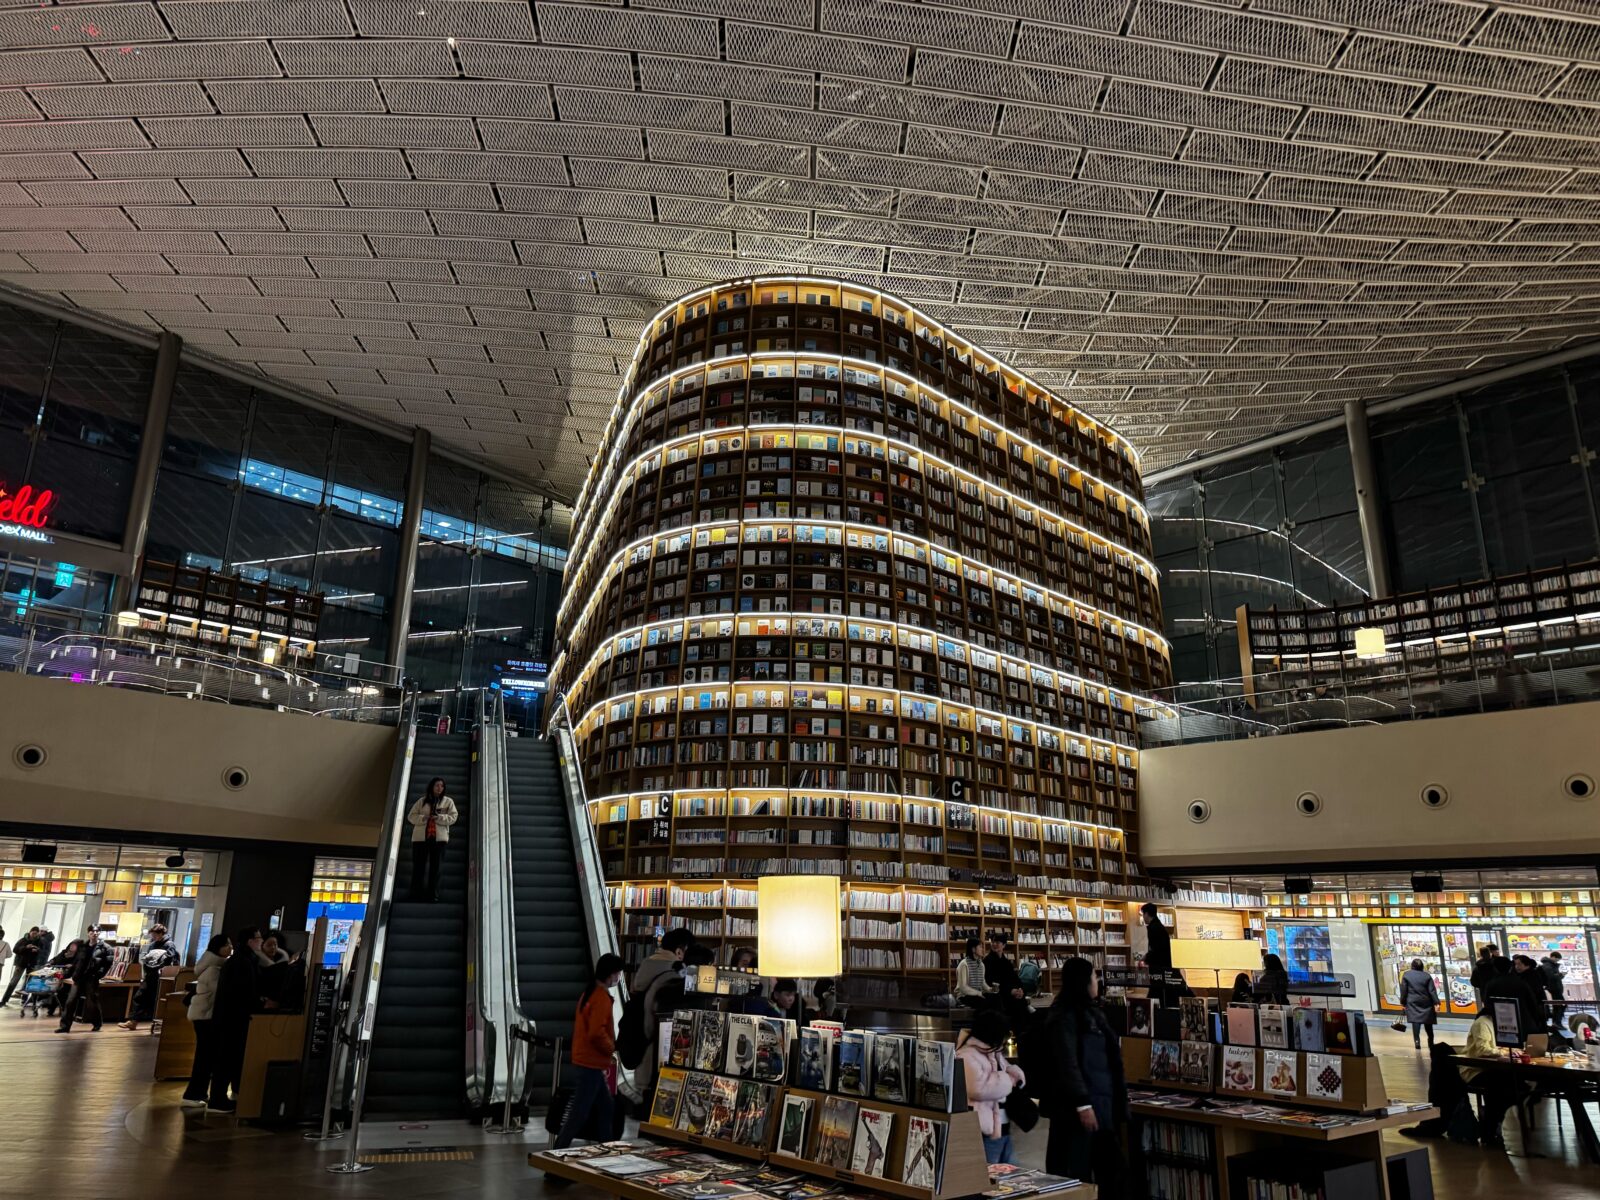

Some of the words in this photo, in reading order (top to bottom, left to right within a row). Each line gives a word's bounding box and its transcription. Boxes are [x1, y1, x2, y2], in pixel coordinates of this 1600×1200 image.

[21, 530, 48, 541] MALL
[952, 780, 962, 797] C
[661, 796, 669, 813] C
[731, 1016, 740, 1024] THE
